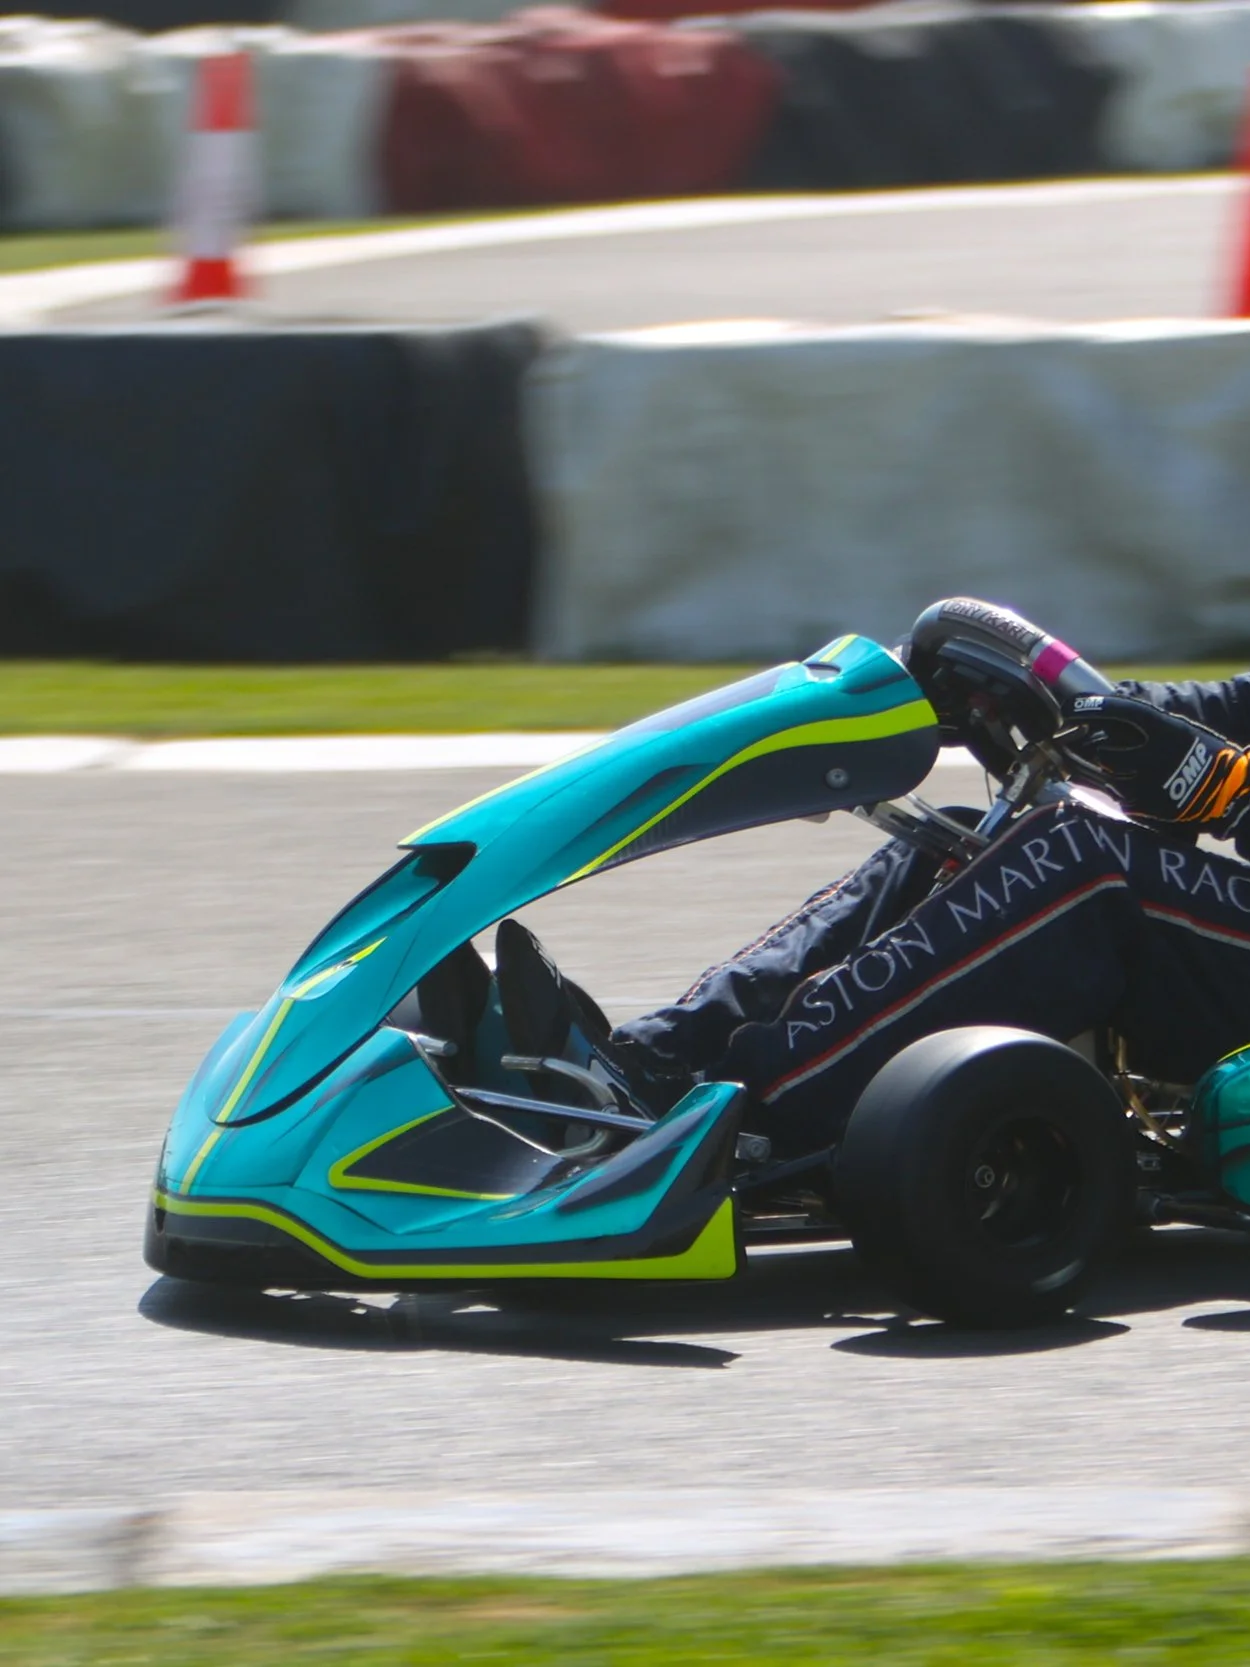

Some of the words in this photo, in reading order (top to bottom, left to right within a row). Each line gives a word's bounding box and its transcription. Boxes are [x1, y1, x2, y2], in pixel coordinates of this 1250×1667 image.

[1074, 696, 1104, 709] OMP
[1169, 743, 1207, 801] OMP
[786, 919, 936, 1049] ASTON
